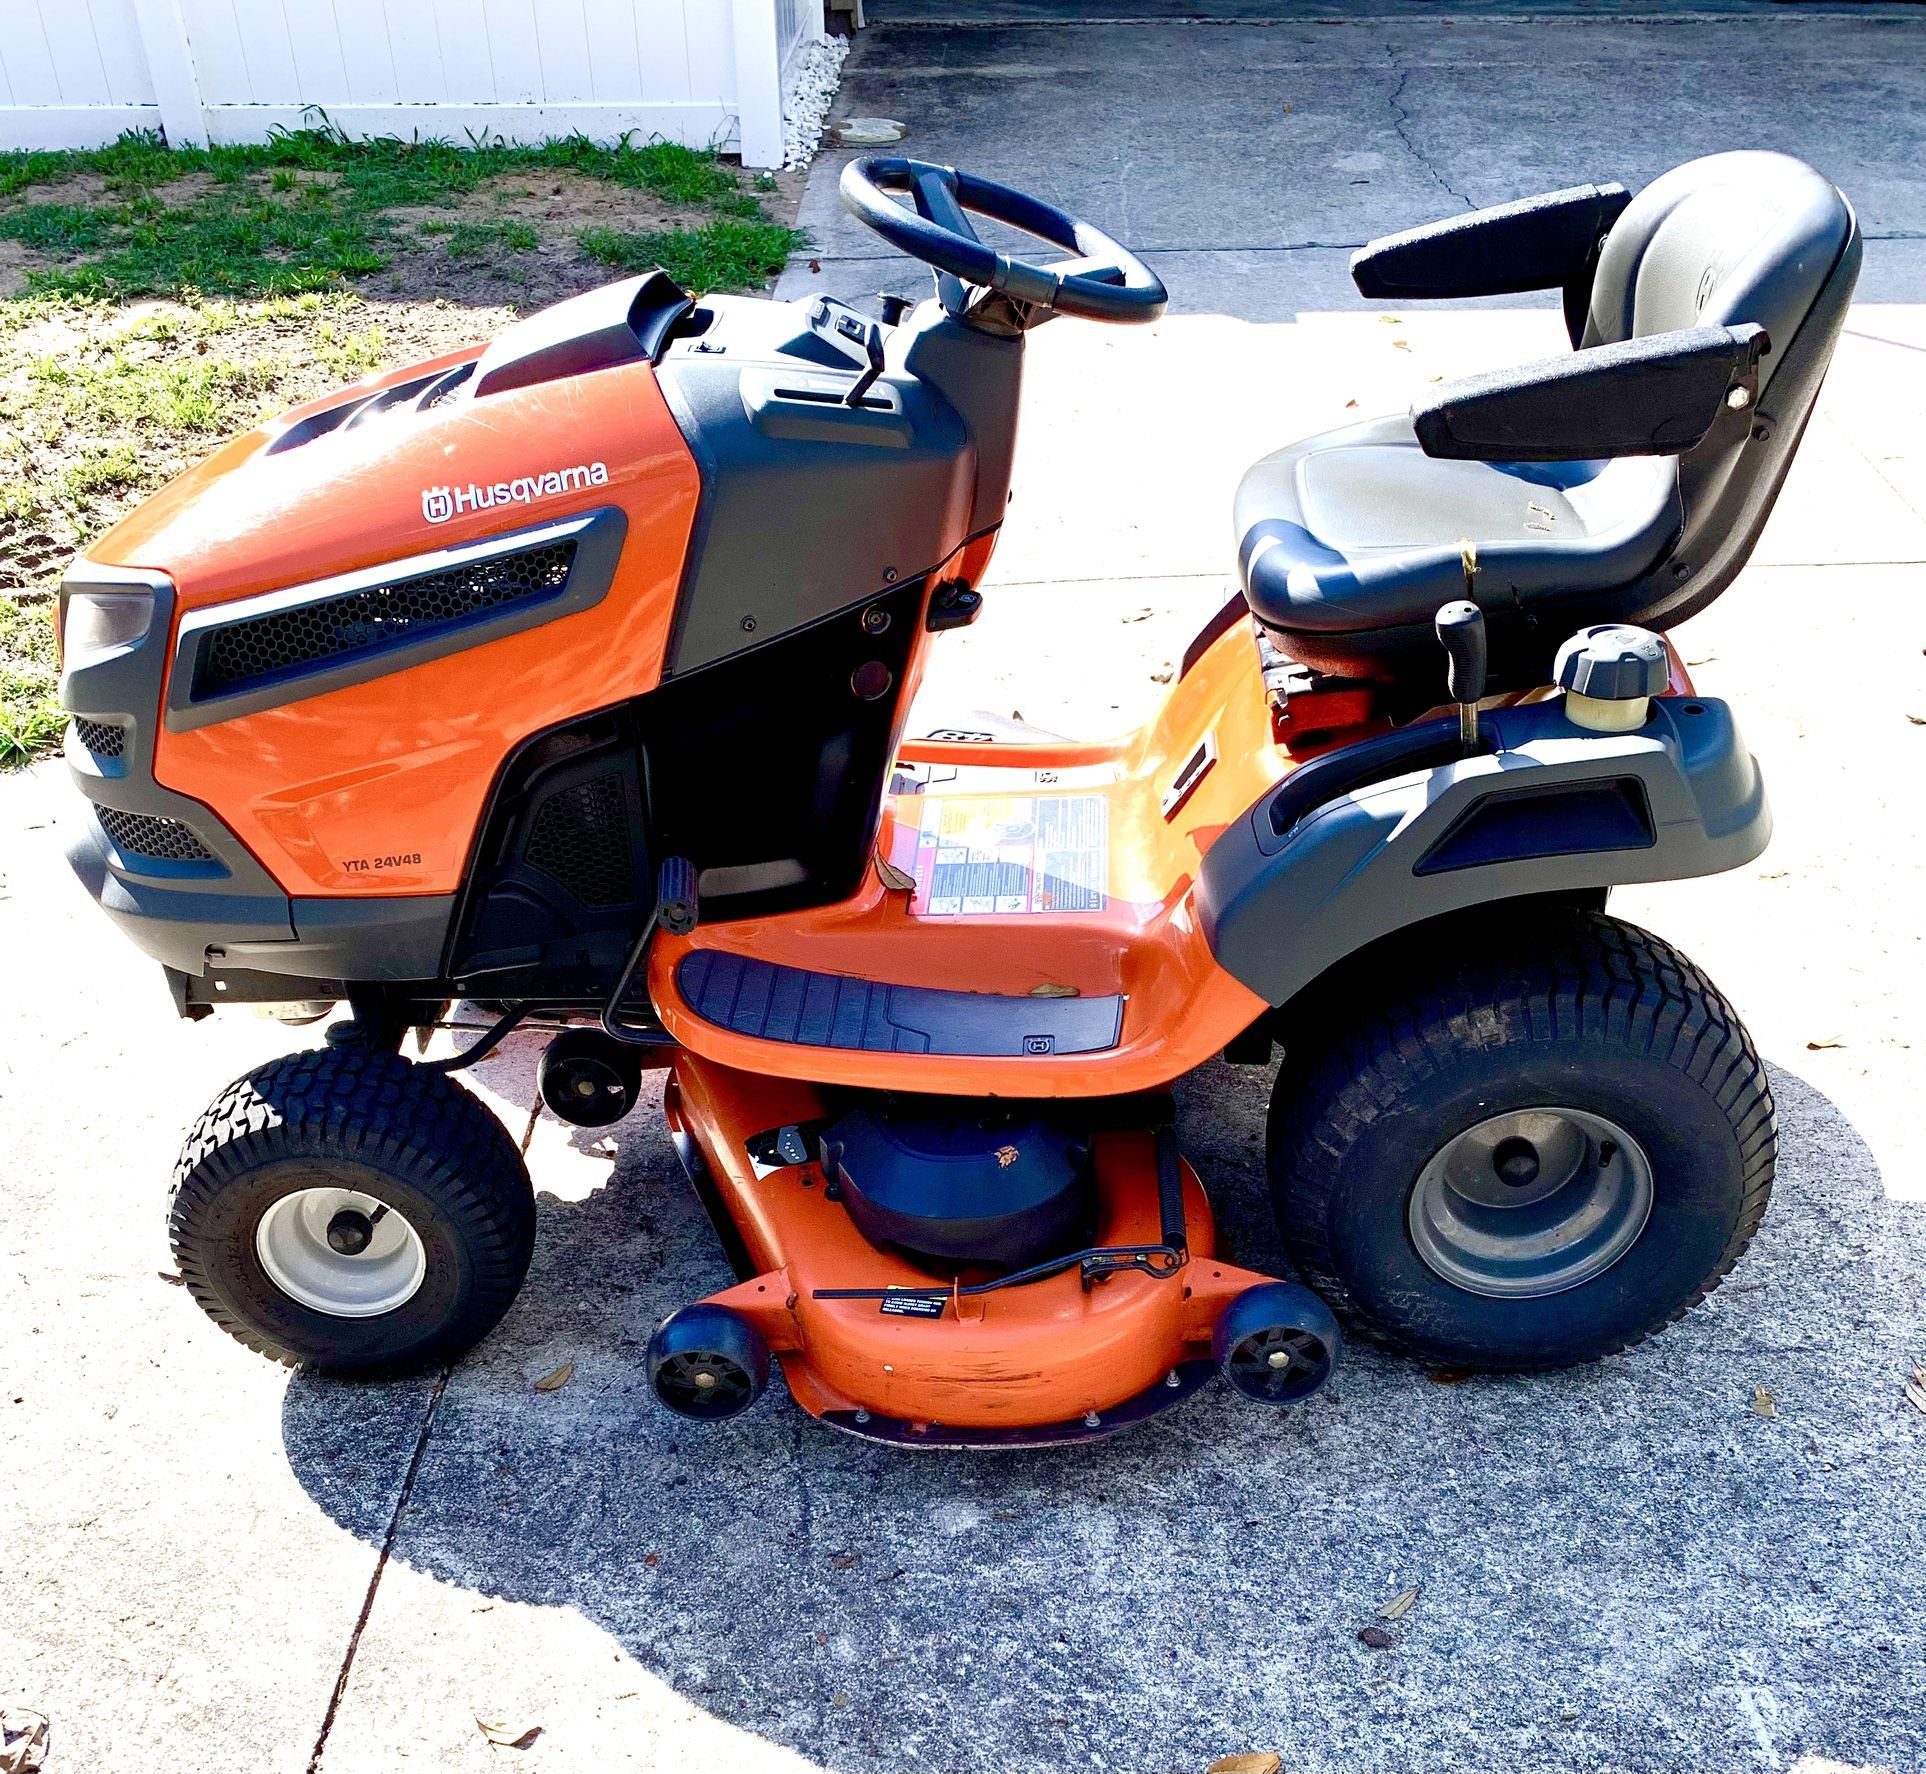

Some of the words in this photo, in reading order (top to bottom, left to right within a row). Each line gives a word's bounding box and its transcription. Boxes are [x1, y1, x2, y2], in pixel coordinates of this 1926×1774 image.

[454, 460, 609, 513] Husqvarna
[342, 859, 370, 872] YTA
[374, 853, 422, 869] 24V48
